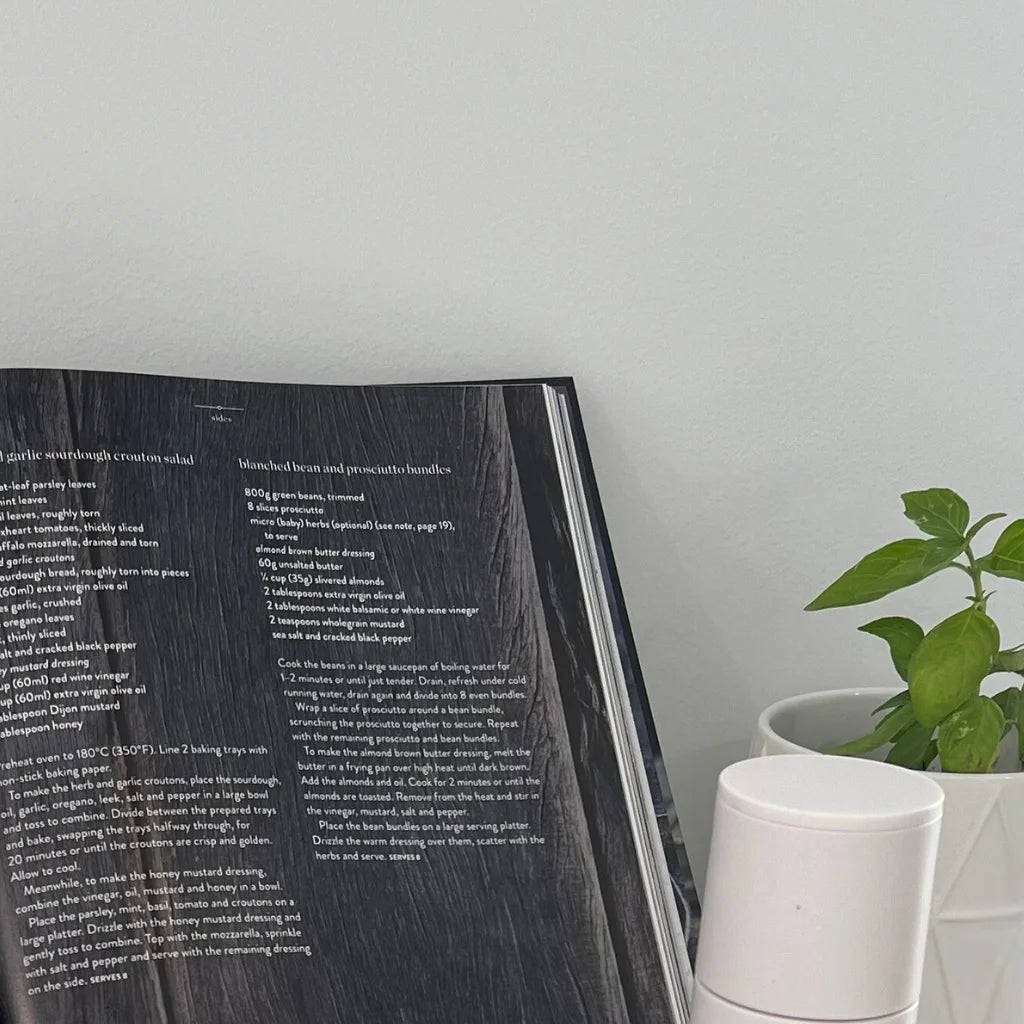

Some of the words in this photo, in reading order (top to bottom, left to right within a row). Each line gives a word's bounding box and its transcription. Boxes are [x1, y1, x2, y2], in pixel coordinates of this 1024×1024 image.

[7, 449, 42, 463] garlic
[45, 449, 111, 462] sourdough
[113, 451, 160, 462] crouton
[163, 453, 194, 465] salad
[239, 459, 290, 472] blanched
[293, 461, 321, 473] bean
[323, 463, 345, 474] and
[346, 464, 405, 476] prosciutto
[407, 465, 451, 475] bundles
[245, 489, 271, 501] 800g
[272, 491, 296, 501] green
[298, 493, 325, 501] beans,
[328, 493, 364, 502] trimmed
[7, 510, 39, 521] leaves,
[42, 510, 78, 521] roughly
[248, 502, 253, 510] 8
[256, 503, 279, 512] slices
[281, 505, 324, 515] prosciutto
[34, 523, 82, 534] tomatoes,
[84, 523, 115, 534] thickly
[118, 524, 144, 532] sliced
[28, 539, 81, 549] mozzarella,
[83, 538, 118, 547] drained
[120, 538, 137, 547] and
[139, 540, 158, 548] torn
[256, 546, 286, 555] almond
[288, 546, 313, 555] brown
[315, 547, 340, 557] butter
[342, 549, 375, 560] dressing
[7, 556, 33, 568] garlic
[35, 554, 75, 563] croutons
[258, 559, 277, 570] 60g
[279, 560, 314, 570] unsalted
[316, 562, 343, 571] butter
[48, 568, 79, 578] bread,
[82, 567, 117, 579] roughly
[119, 568, 139, 576] torn
[141, 568, 159, 576] into
[162, 569, 189, 579] pieces
[11, 601, 41, 613] garlic,
[43, 598, 82, 608] crushed
[7, 632, 36, 644] thinly
[39, 628, 66, 639] sliced
[15, 647, 33, 656] and
[36, 643, 73, 654] cracked
[76, 641, 101, 651] black
[104, 641, 137, 651] pepper
[10, 662, 49, 673] mustard
[51, 658, 89, 670] dressing
[278, 658, 302, 669] Cook
[304, 660, 318, 669] the
[320, 661, 346, 670] beans
[348, 662, 355, 670] in
[365, 662, 386, 674] large
[389, 663, 428, 673] saucepan
[430, 662, 439, 671] of
[441, 662, 470, 674] boiling
[472, 662, 496, 671] water
[498, 662, 511, 670] for
[50, 704, 78, 718] Dijon
[81, 700, 120, 711] mustard
[52, 720, 83, 731] honey
[290, 718, 338, 730] scrunching
[339, 719, 353, 728] the
[356, 720, 400, 730] prosciutto
[402, 720, 440, 731] together
[443, 720, 451, 728] to
[454, 721, 485, 729] secure.
[488, 720, 518, 730] Repeat
[46, 767, 80, 779] baking
[82, 764, 112, 778] paper.
[3, 823, 22, 835] and
[24, 818, 45, 830] toss
[48, 816, 58, 826] to
[62, 812, 108, 824] combine.
[112, 808, 144, 820] Divide
[146, 806, 188, 816] between
[191, 805, 207, 815] the
[210, 806, 251, 817] prepared
[254, 805, 276, 818] trays
